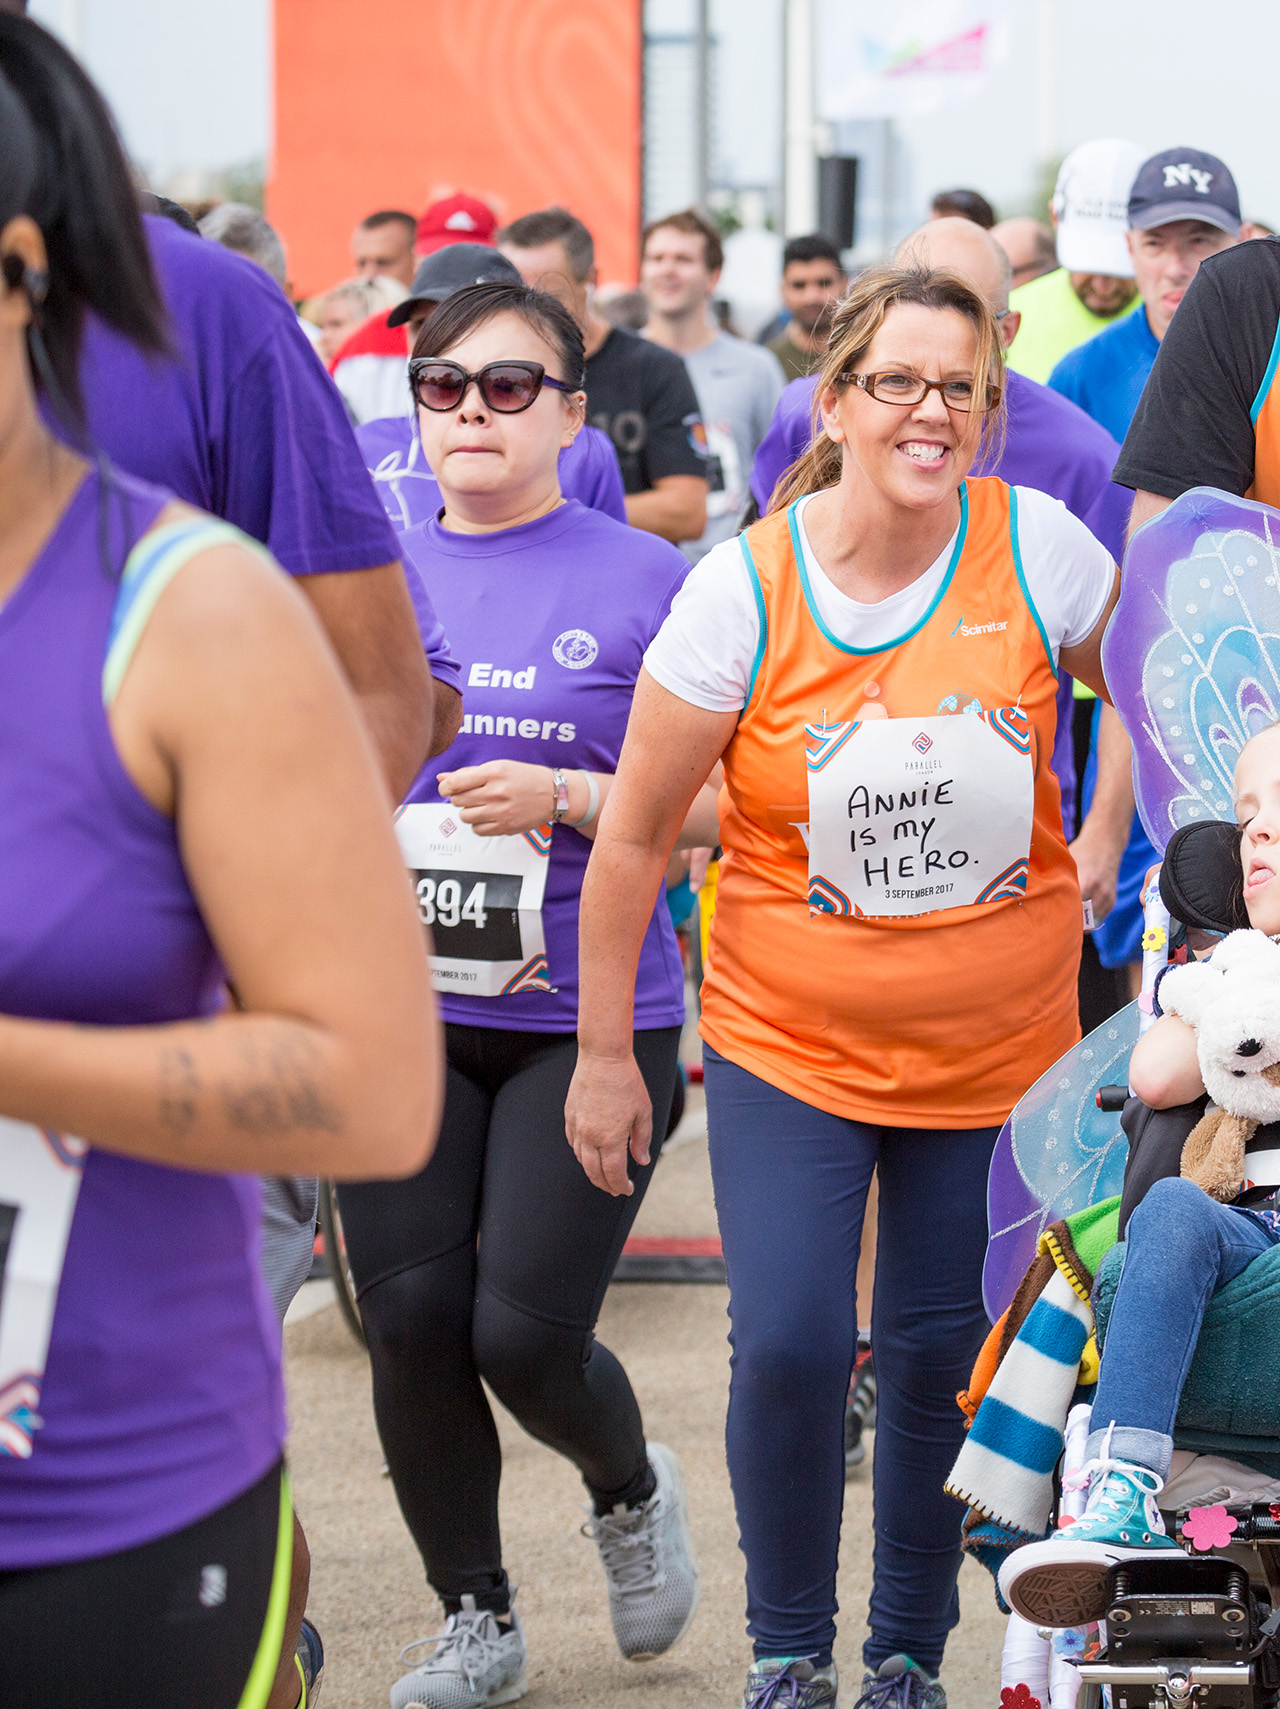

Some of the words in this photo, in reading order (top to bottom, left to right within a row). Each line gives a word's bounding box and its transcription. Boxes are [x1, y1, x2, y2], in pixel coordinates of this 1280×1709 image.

[1162, 163, 1213, 194] NY
[961, 621, 1008, 636] Scimitar
[467, 663, 537, 690] End
[458, 713, 577, 743] unners
[904, 760, 942, 770] PARALLEL
[864, 850, 979, 887] HERO.
[409, 877, 488, 928] 394
[885, 889, 891, 898] 3
[891, 886, 934, 899] SEPTEMBER
[935, 883, 954, 895] 2017
[460, 972, 477, 981] 2017
